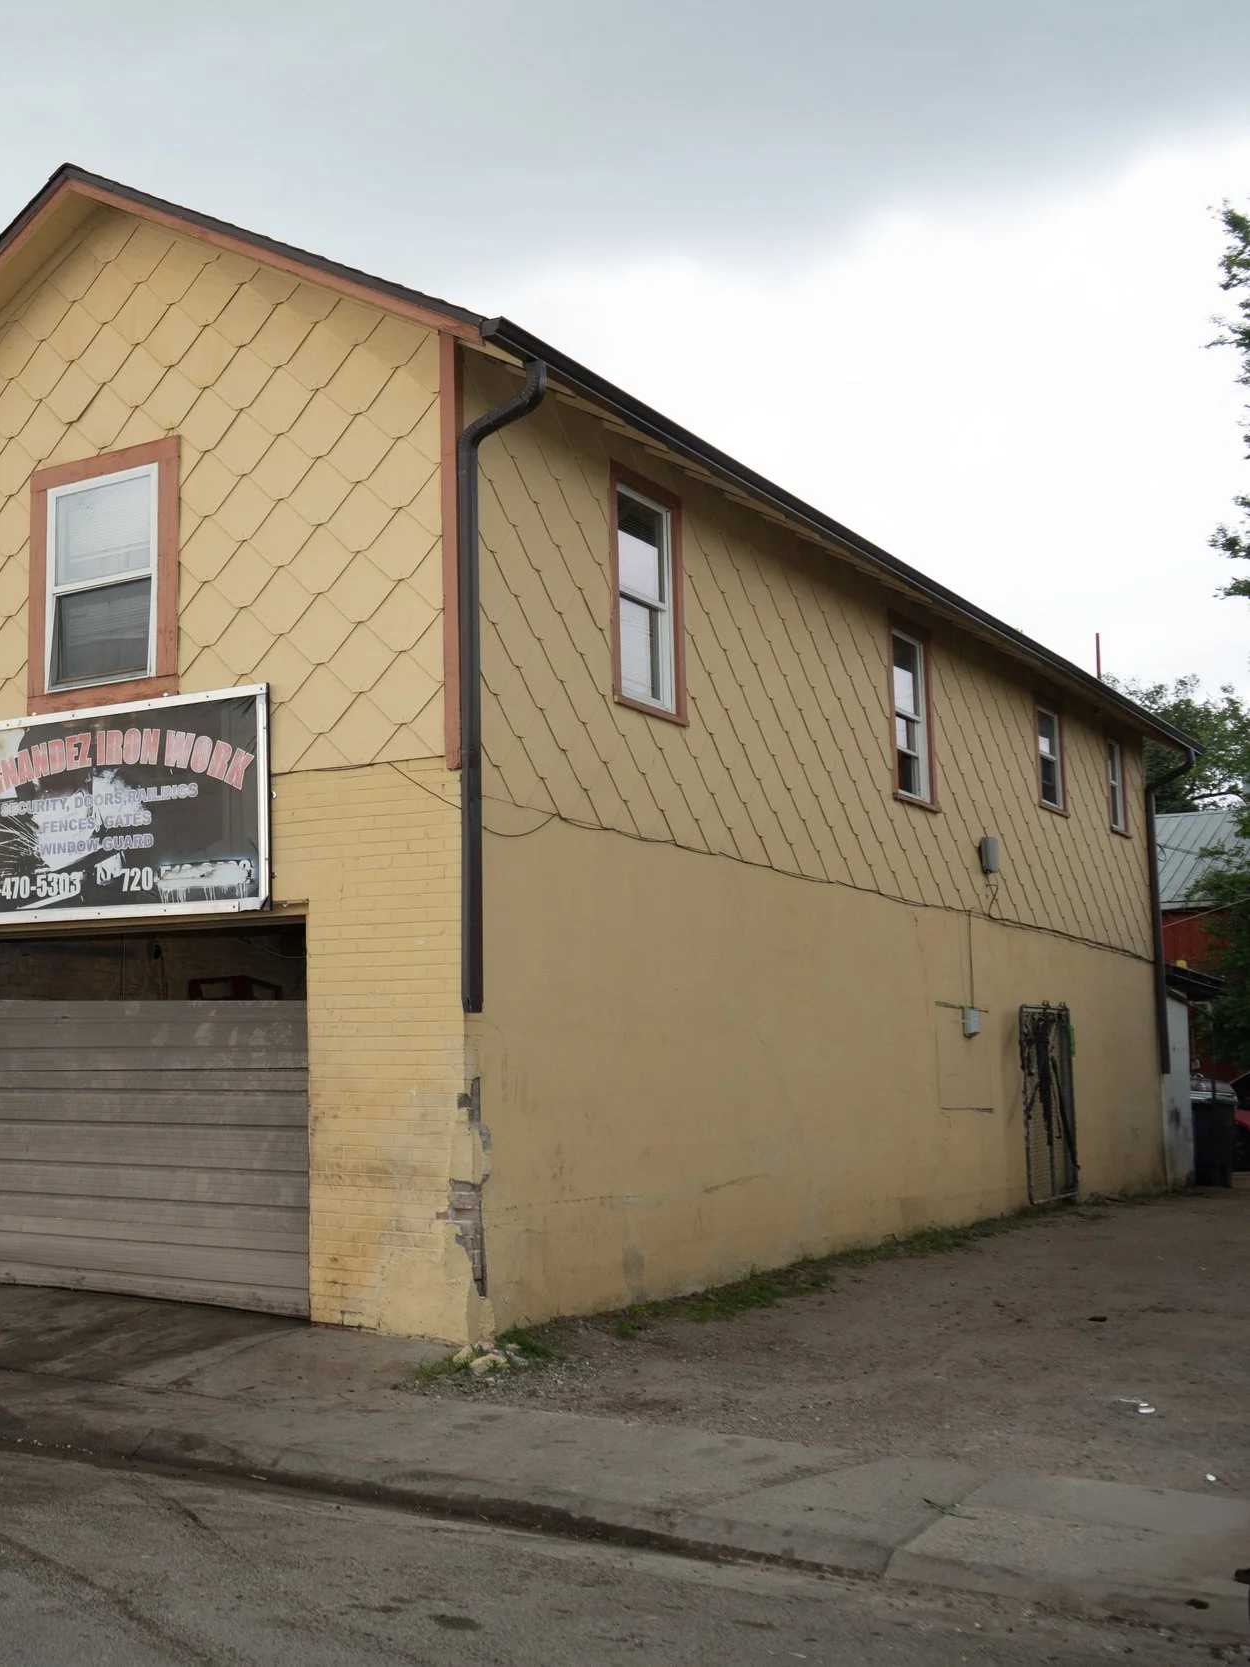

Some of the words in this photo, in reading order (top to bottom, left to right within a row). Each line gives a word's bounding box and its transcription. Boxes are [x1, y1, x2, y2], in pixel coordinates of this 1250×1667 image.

[96, 728, 161, 766] IRON
[164, 729, 255, 791] WORK
[0, 797, 70, 818] SECURITY,
[43, 816, 101, 834] FENCES,
[104, 811, 152, 829] GATES
[40, 836, 99, 856] WINDOW
[102, 833, 155, 851] GUARD
